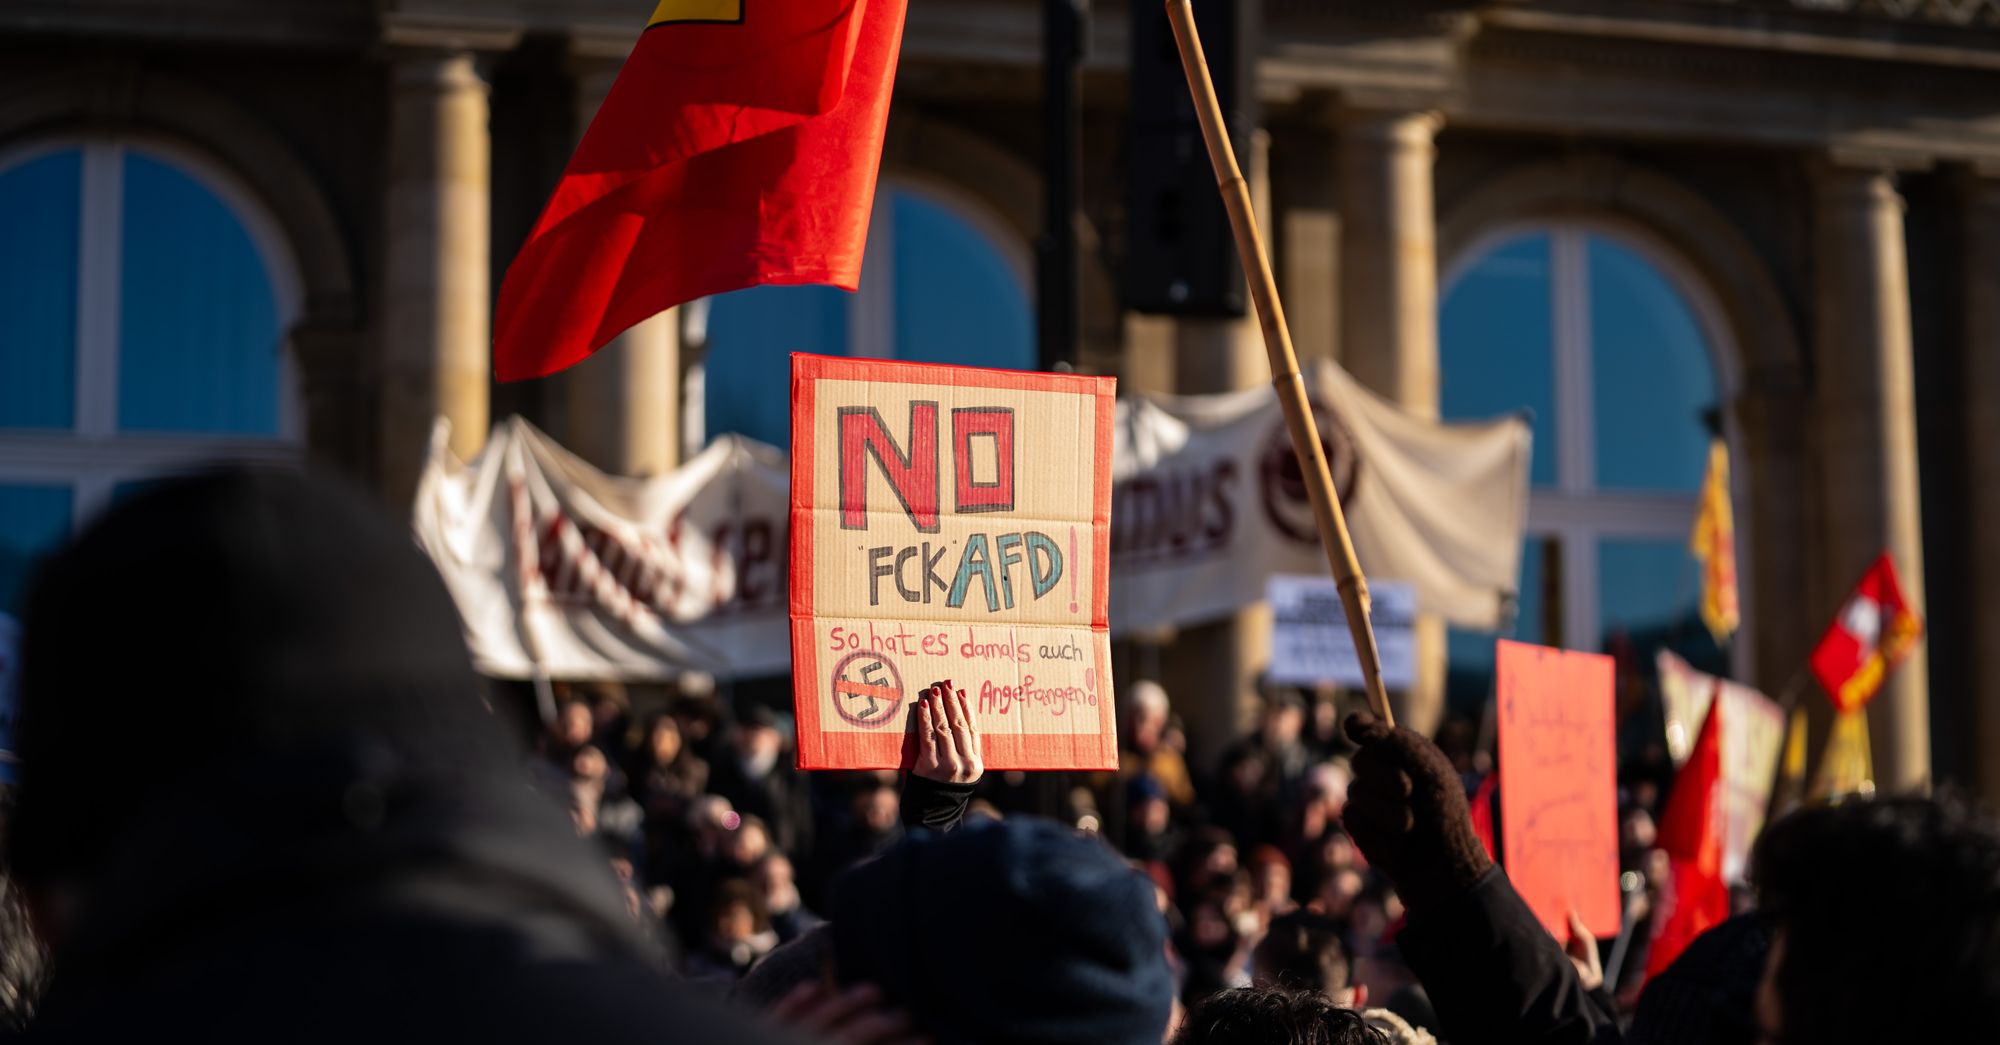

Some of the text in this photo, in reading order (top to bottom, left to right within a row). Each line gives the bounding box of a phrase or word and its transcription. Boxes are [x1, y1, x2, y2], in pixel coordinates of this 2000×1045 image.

[837, 400, 1014, 534] NO
[868, 621, 917, 656] hat
[921, 632, 949, 656] es
[960, 626, 1031, 662] damals
[1038, 633, 1083, 662] auch
